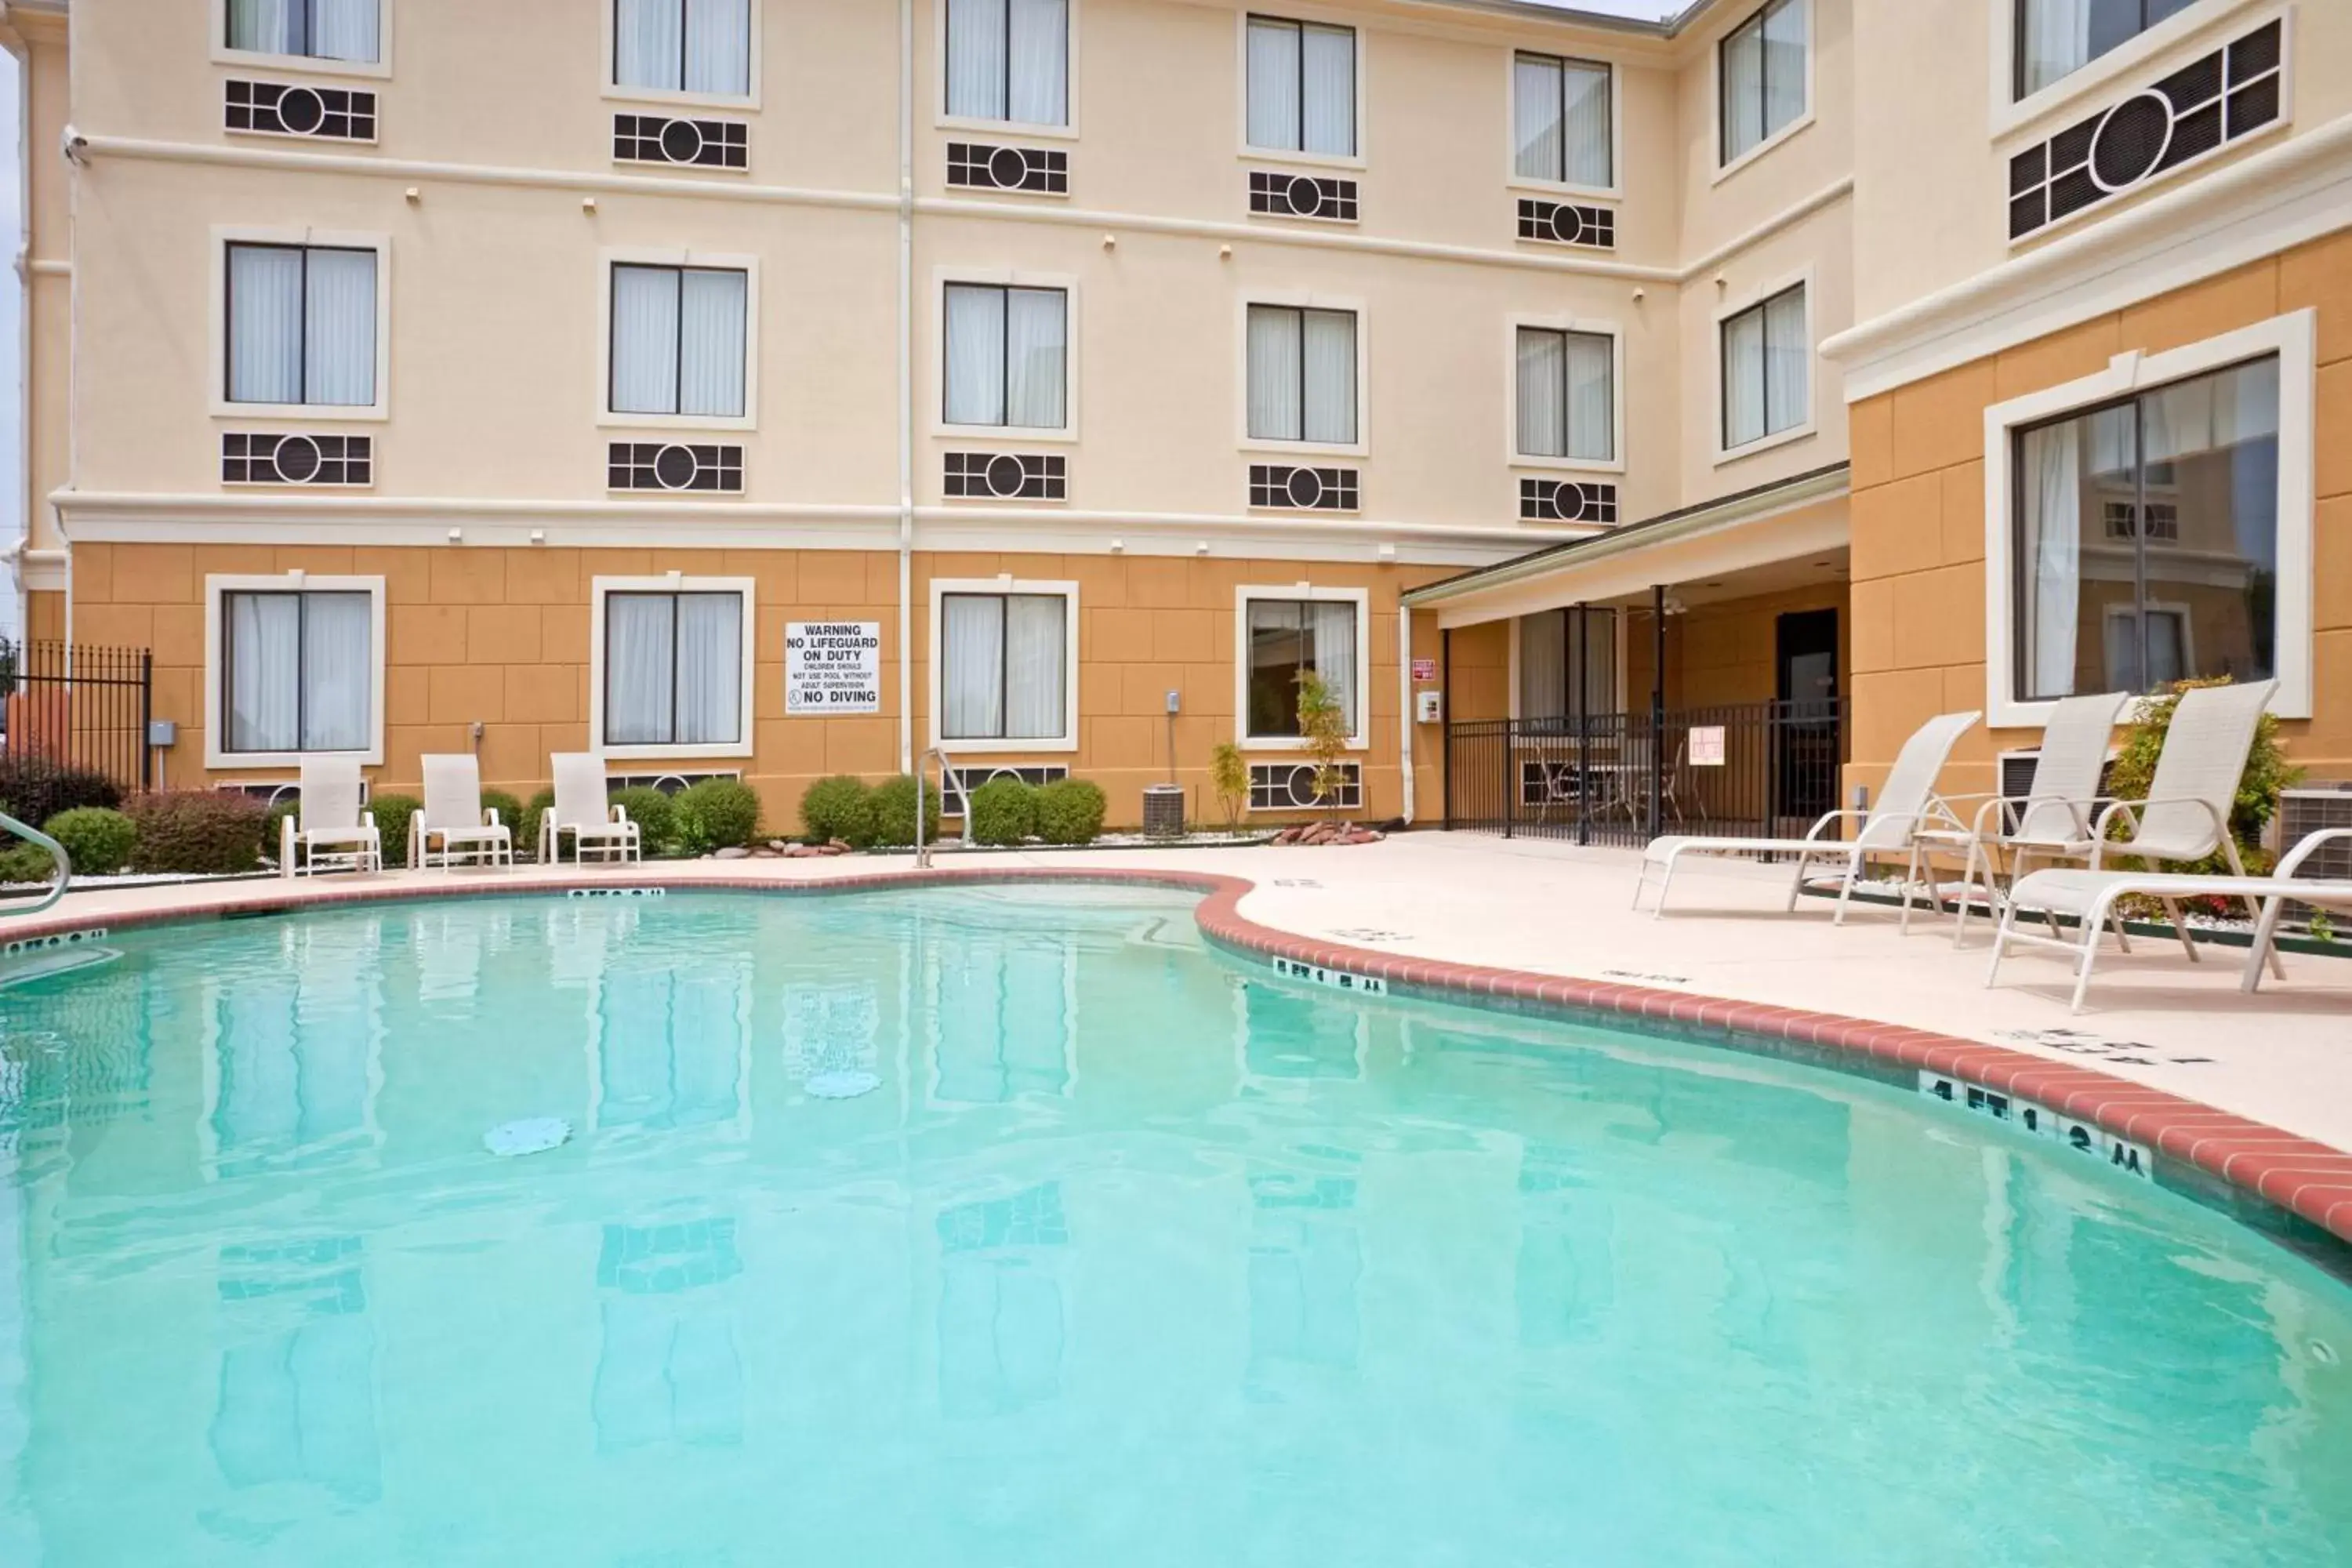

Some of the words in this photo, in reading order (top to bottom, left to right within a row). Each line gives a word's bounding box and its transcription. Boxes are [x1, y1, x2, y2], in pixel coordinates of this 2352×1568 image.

[804, 625, 862, 636] WARNING
[786, 637, 804, 648] NO
[811, 637, 877, 648] LIFEGUARD
[804, 650, 821, 661] ON
[827, 650, 862, 661] DUTY
[804, 691, 823, 703] NO
[830, 691, 876, 702] DIVING
